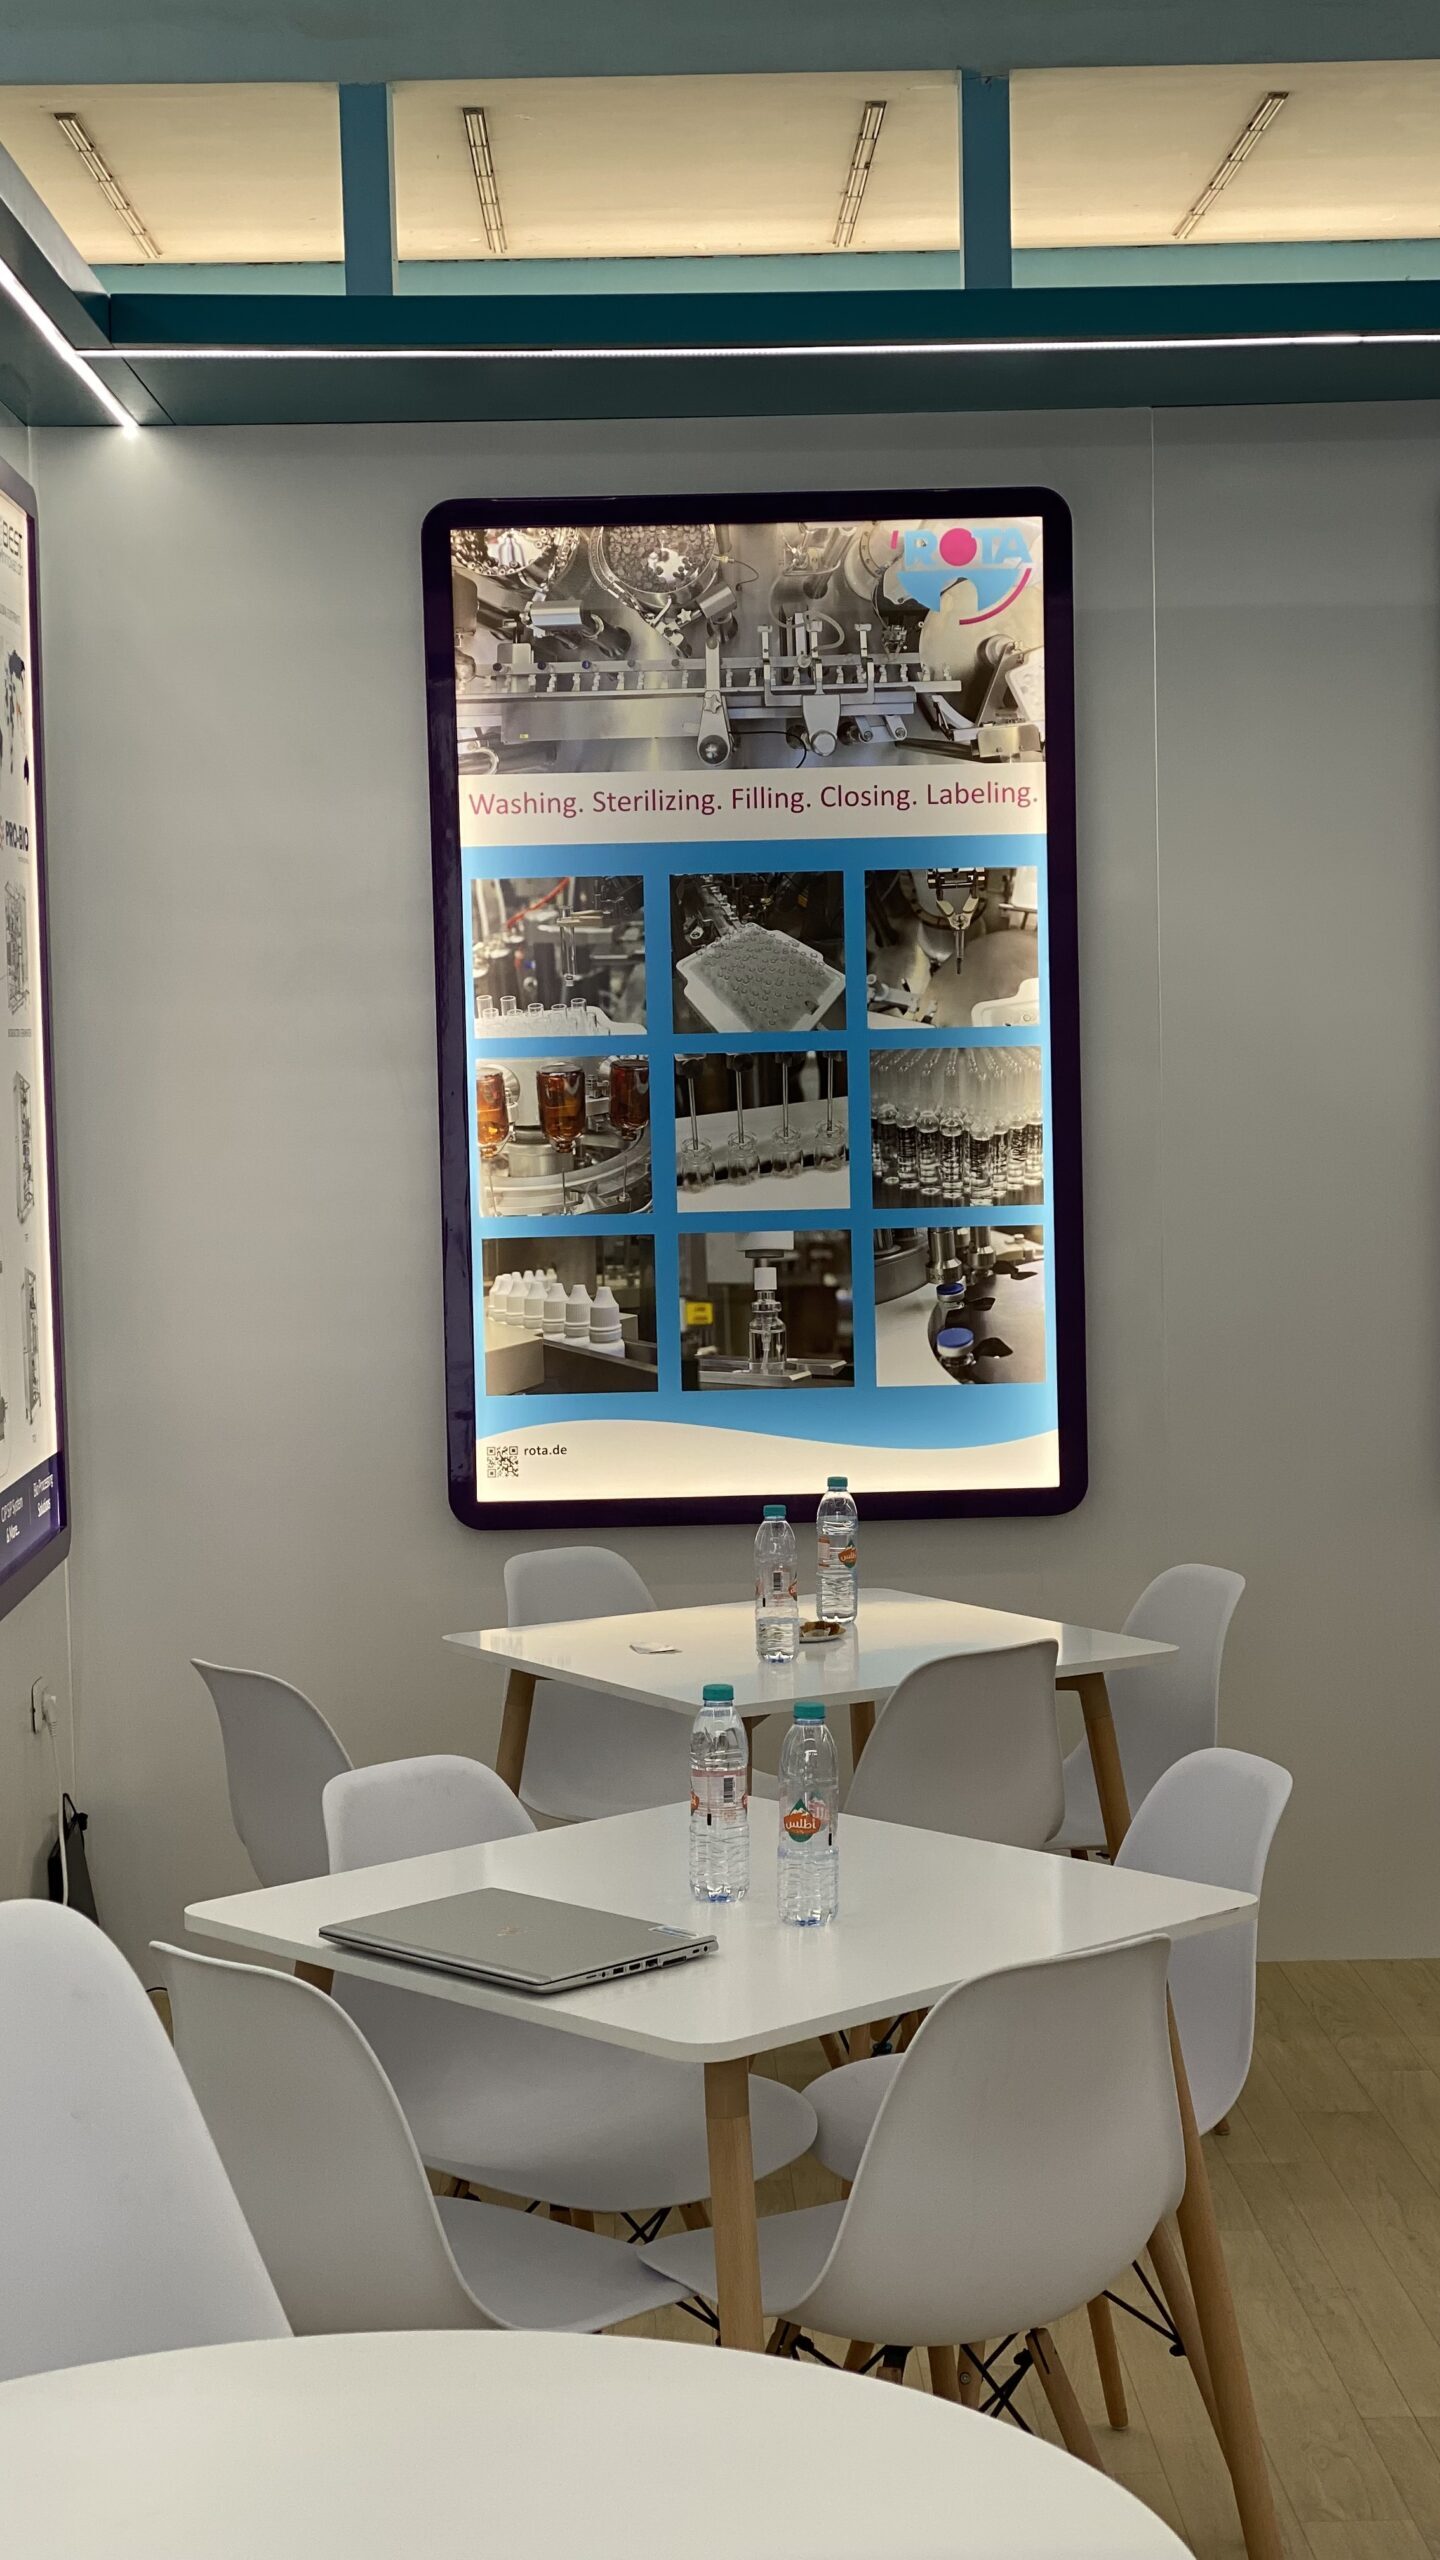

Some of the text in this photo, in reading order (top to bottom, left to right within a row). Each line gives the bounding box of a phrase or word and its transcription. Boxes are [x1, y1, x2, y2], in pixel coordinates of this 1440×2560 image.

[904, 527, 1033, 567] ROTA
[468, 781, 1038, 818] Washing. Sterilizing. Filling. Closing. Labeling.
[524, 1444, 567, 1456] rota.de
